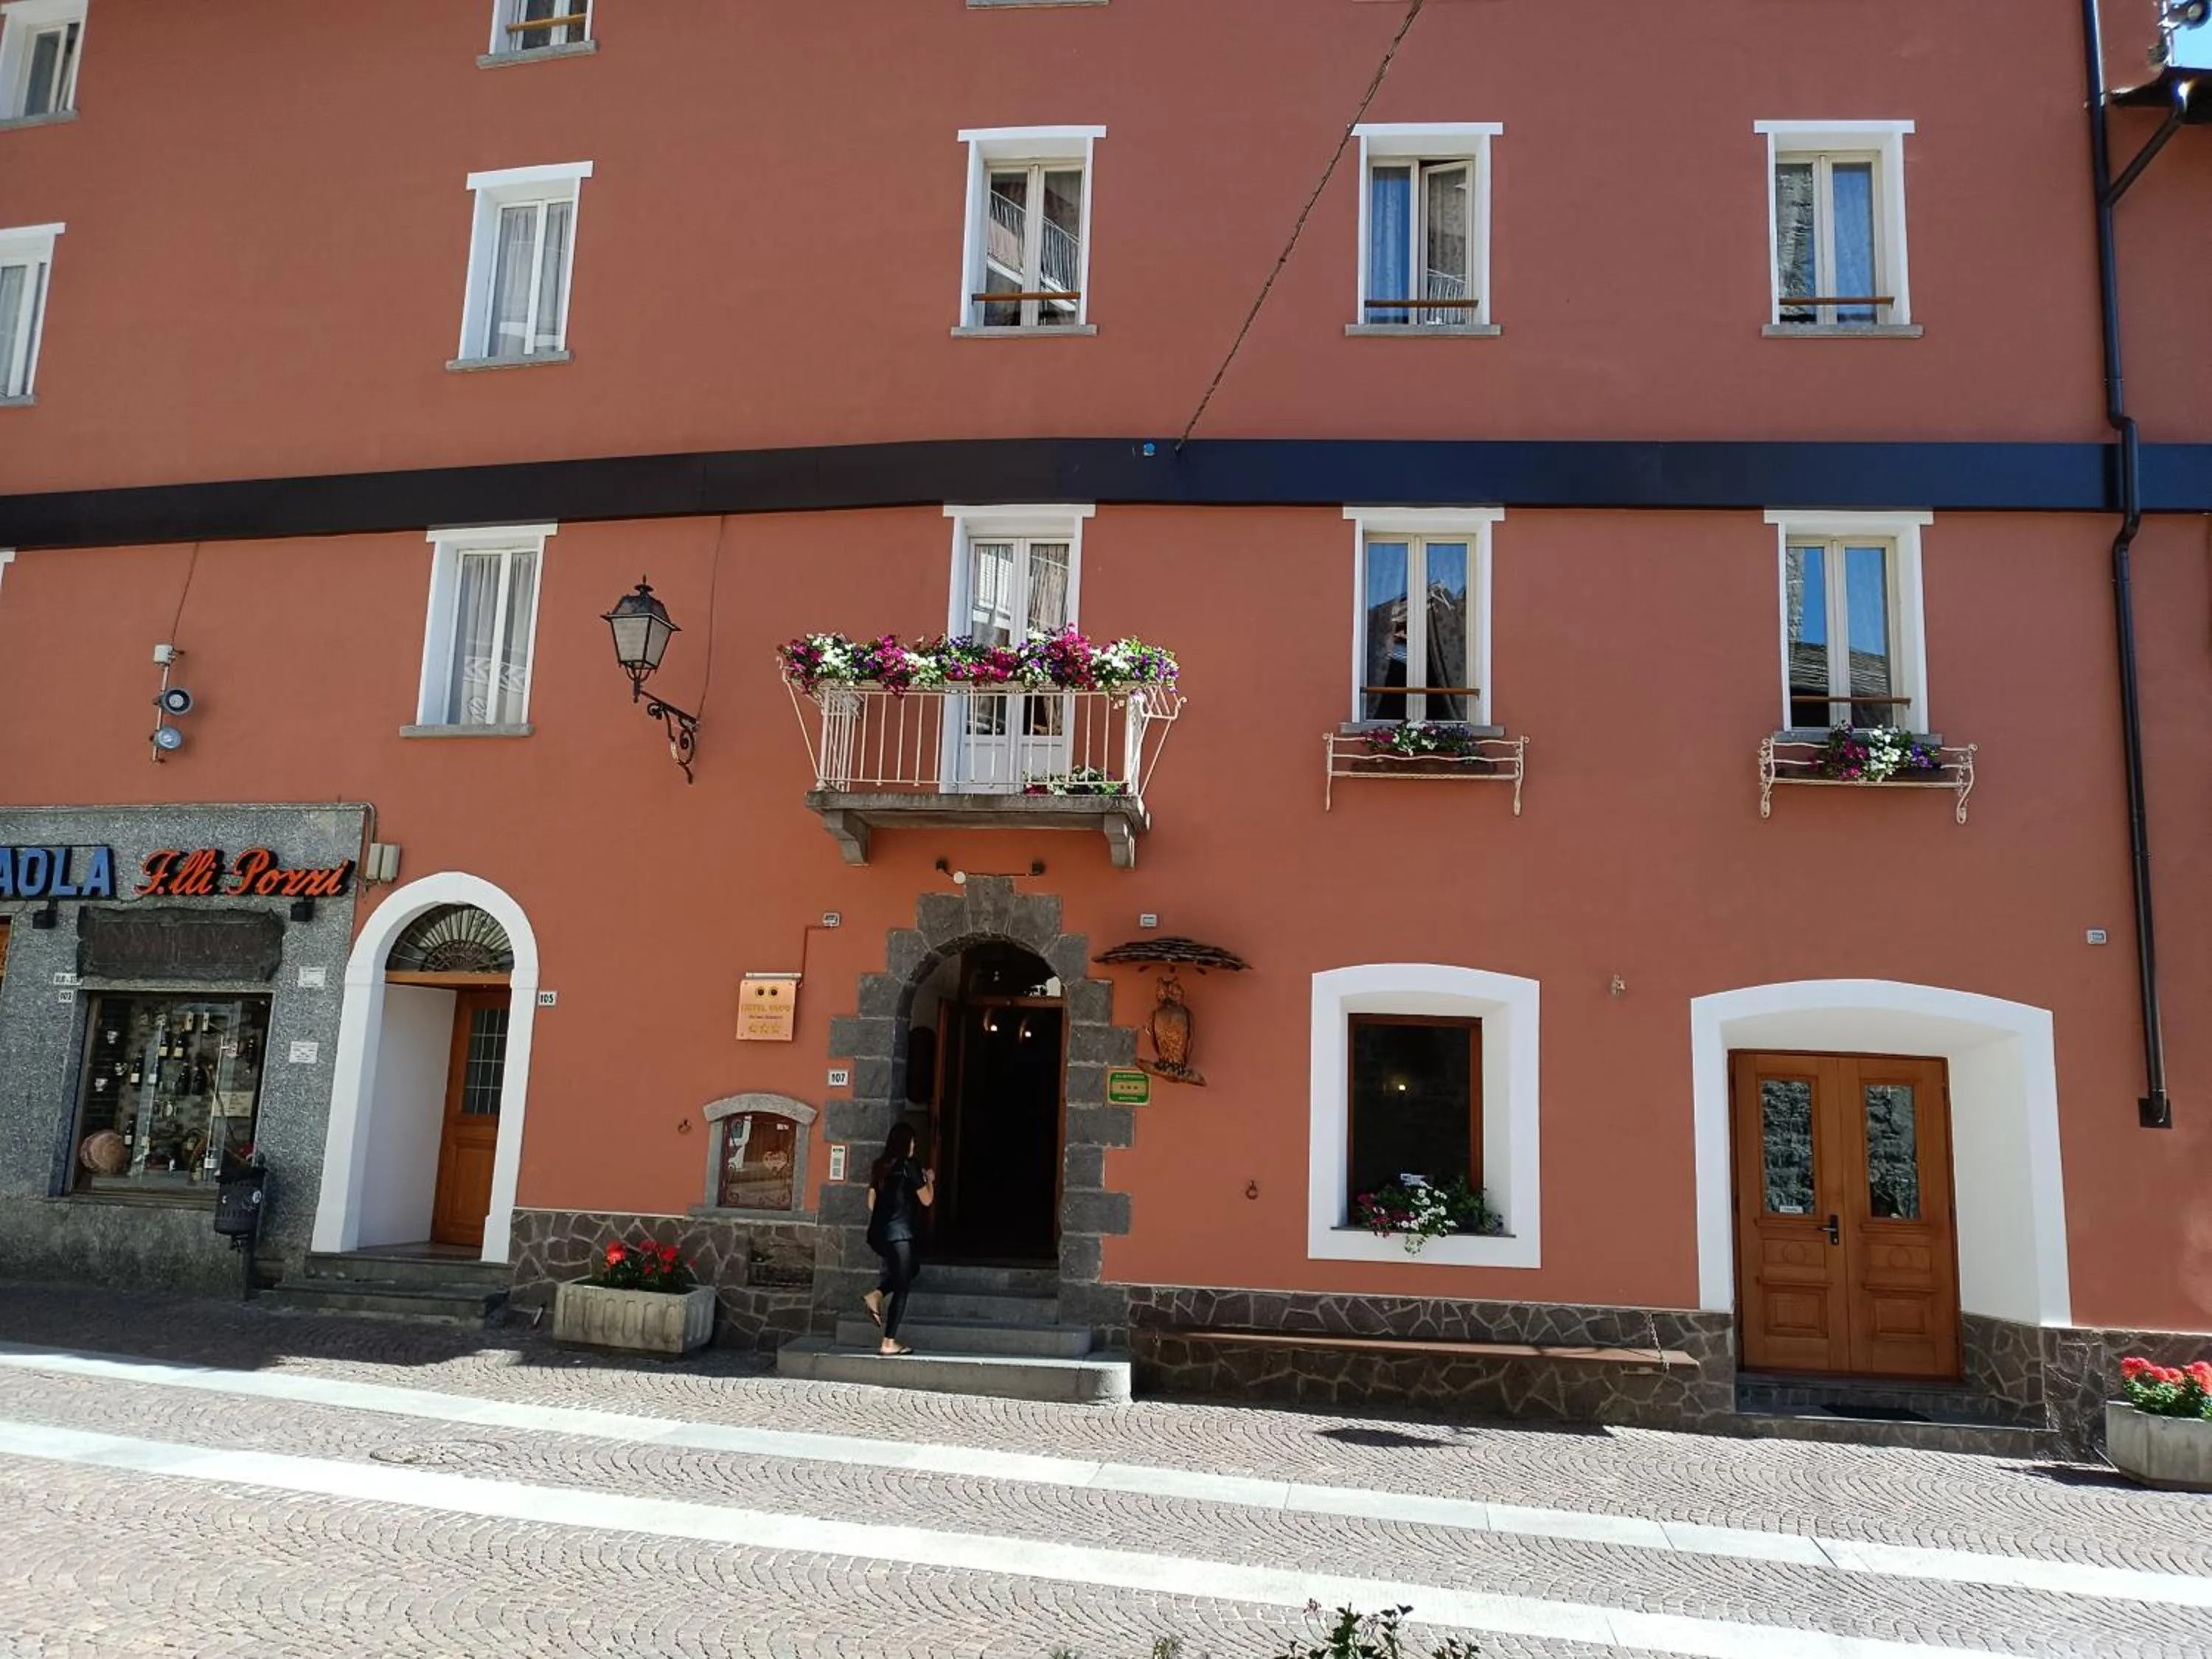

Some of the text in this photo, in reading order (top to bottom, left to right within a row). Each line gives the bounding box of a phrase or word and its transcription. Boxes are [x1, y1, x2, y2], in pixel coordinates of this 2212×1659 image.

[226, 849, 349, 896] Pozzi
[540, 993, 554, 1003] 105
[831, 1073, 845, 1083] 107
